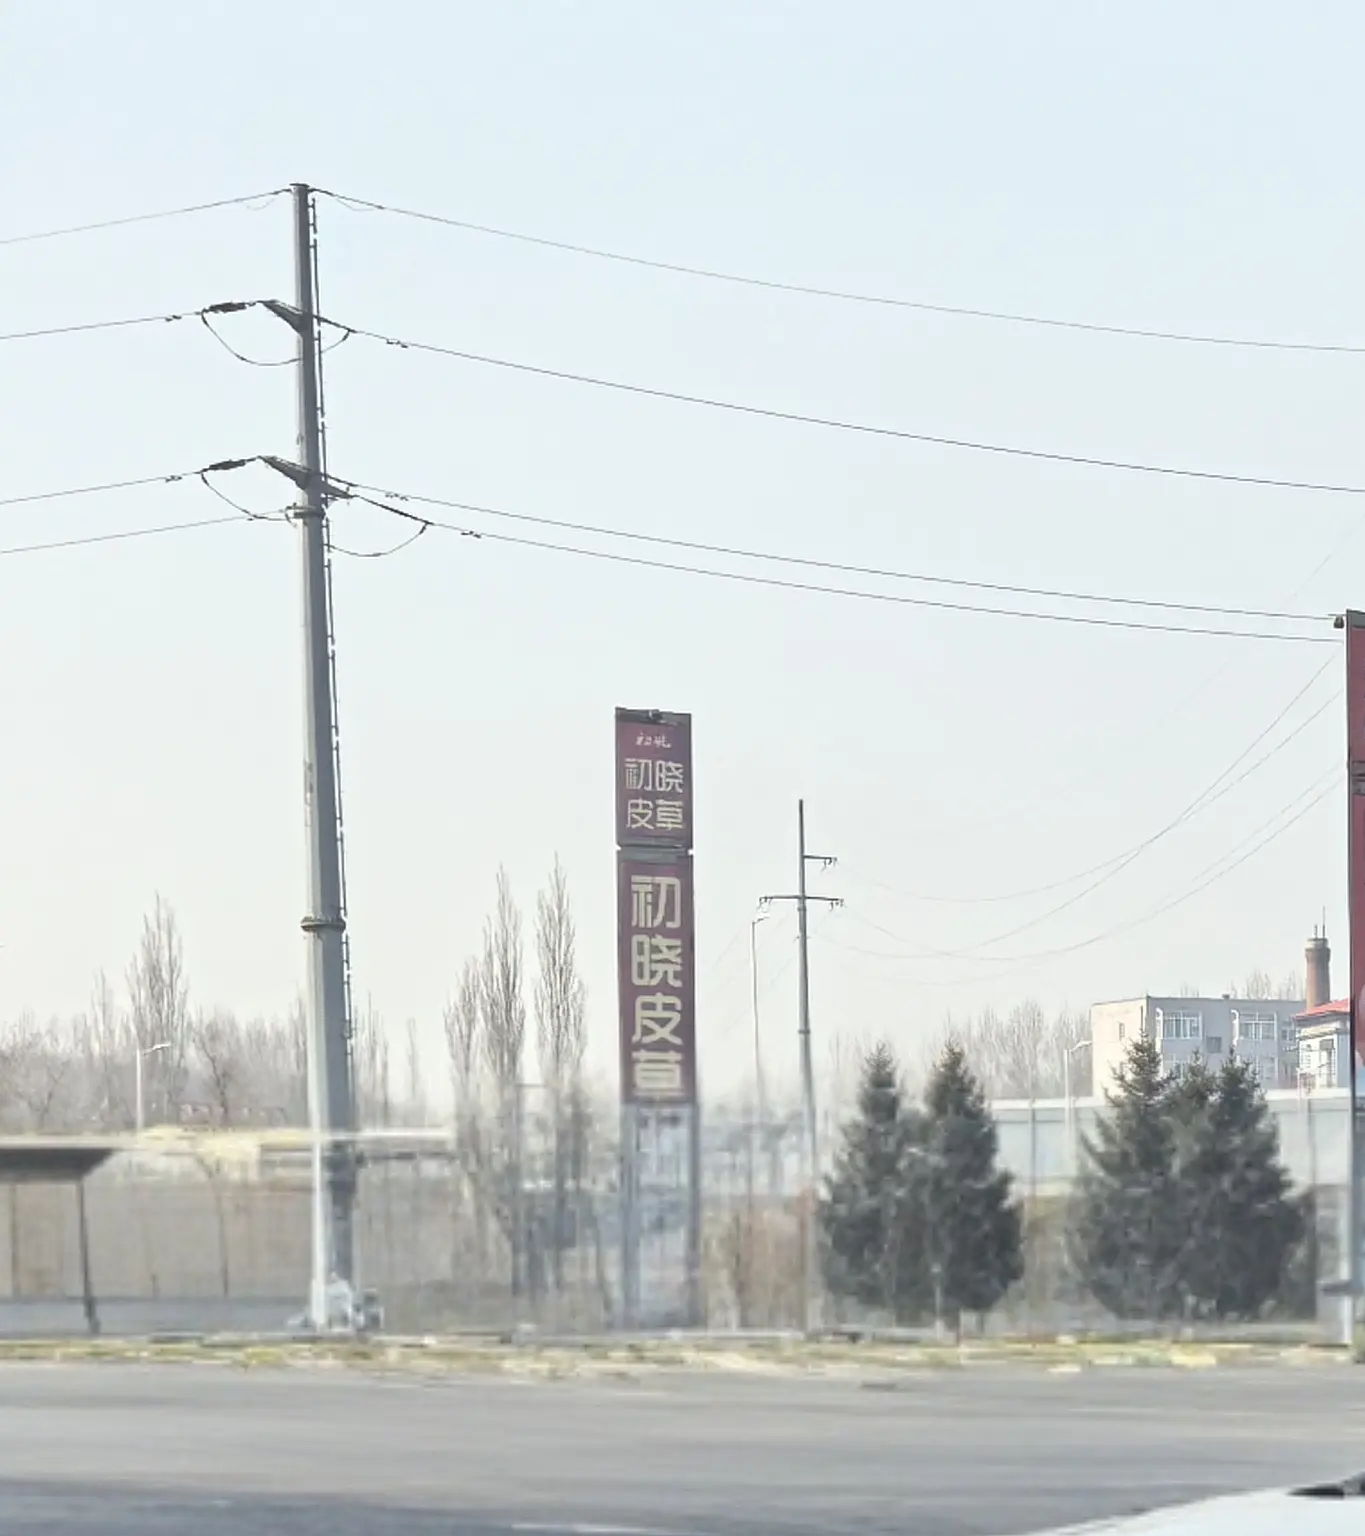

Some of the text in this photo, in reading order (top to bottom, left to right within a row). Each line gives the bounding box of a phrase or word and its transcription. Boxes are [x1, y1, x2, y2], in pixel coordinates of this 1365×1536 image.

[624, 758, 684, 793] 初晓
[625, 798, 685, 830] 皮草
[631, 875, 683, 1097] 初晓皮草
